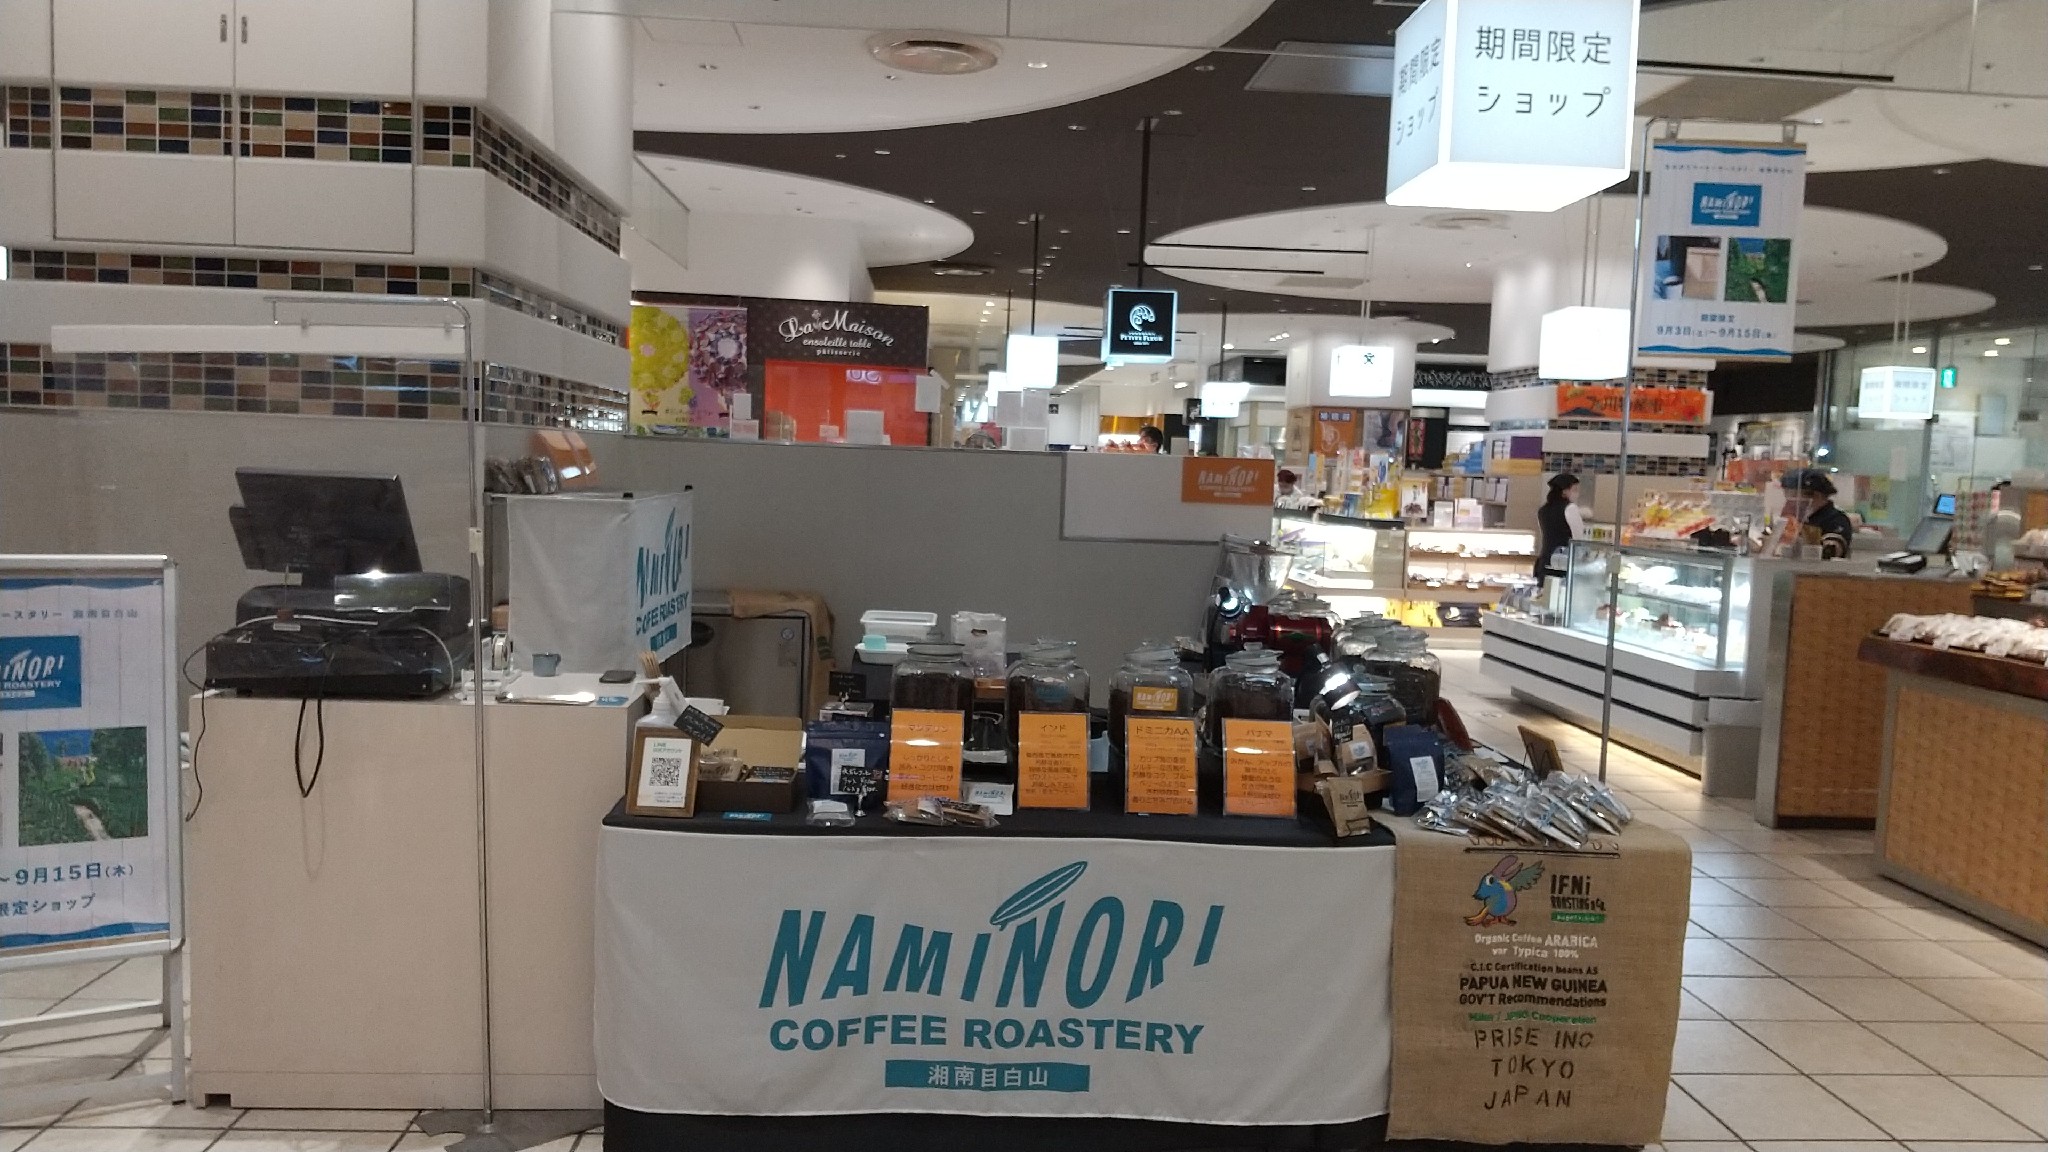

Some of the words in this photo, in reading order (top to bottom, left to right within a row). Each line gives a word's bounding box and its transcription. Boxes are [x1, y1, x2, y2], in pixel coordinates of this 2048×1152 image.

[1475, 26, 1613, 64] 期間限定
[1398, 38, 1441, 95] 期間限定
[1476, 86, 1613, 118] ショップ
[1396, 86, 1439, 146] ショップ
[778, 316, 814, 343] La
[820, 310, 896, 347] Maison
[849, 338, 872, 349] table
[0, 654, 65, 682] INORI
[4, 680, 62, 690] ROASTERY
[1041, 724, 1067, 732] インド
[1136, 726, 1190, 735] ドミニカAA
[1246, 729, 1273, 738] パナマ
[1550, 874, 1591, 895] IFNi
[1474, 933, 1510, 946] Organic
[1512, 933, 1542, 944] Coffee
[1544, 934, 1598, 949] ARABICA
[1513, 945, 1549, 959] Typica
[1554, 948, 1580, 959] 100%
[758, 895, 1225, 1010] NAMINORI
[1495, 962, 1554, 973] Certification
[1555, 965, 1583, 975] beans
[1459, 975, 1510, 991] PAPUA
[1512, 974, 1548, 991] NEW
[1550, 978, 1608, 994] GUINEA
[1459, 993, 1495, 1006] GOV'T
[1498, 993, 1607, 1008] Recommendations
[769, 1013, 948, 1052] COFFEE
[962, 1017, 1205, 1056] ROASTERY
[1474, 1028, 1540, 1050] PRISE
[927, 1064, 1050, 1089] 湘南目白山
[1490, 1055, 1575, 1081] TOKYO
[1484, 1084, 1573, 1111] JAPAN
